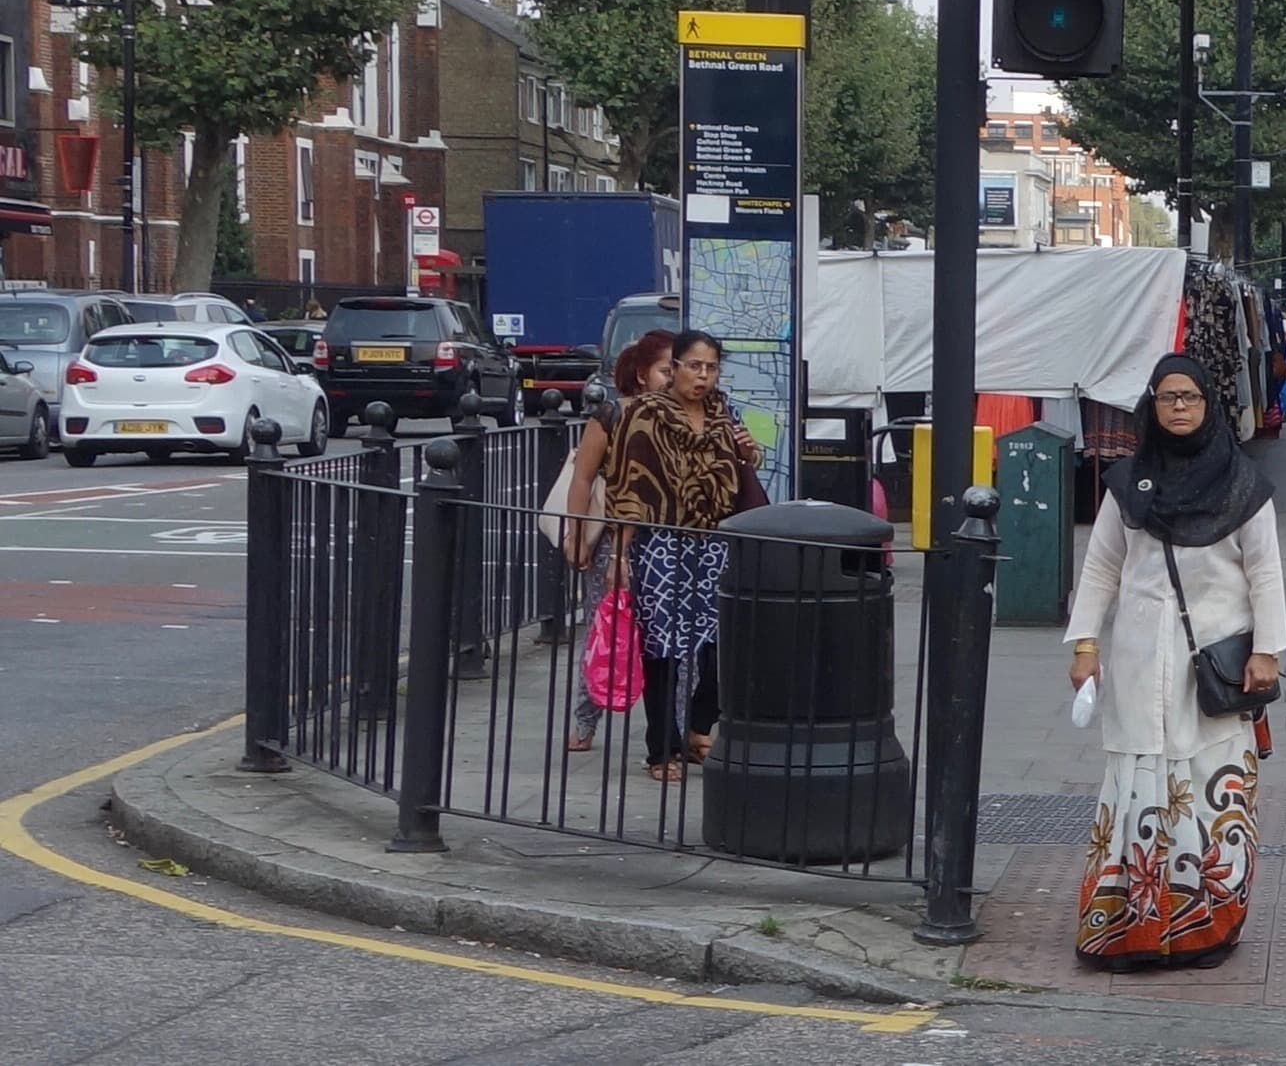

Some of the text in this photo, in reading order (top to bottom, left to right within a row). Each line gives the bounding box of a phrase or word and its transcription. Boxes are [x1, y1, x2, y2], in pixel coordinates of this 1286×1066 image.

[688, 50, 766, 61] BETHNAL GREEN
[688, 60, 783, 72] Bethnal Green Road
